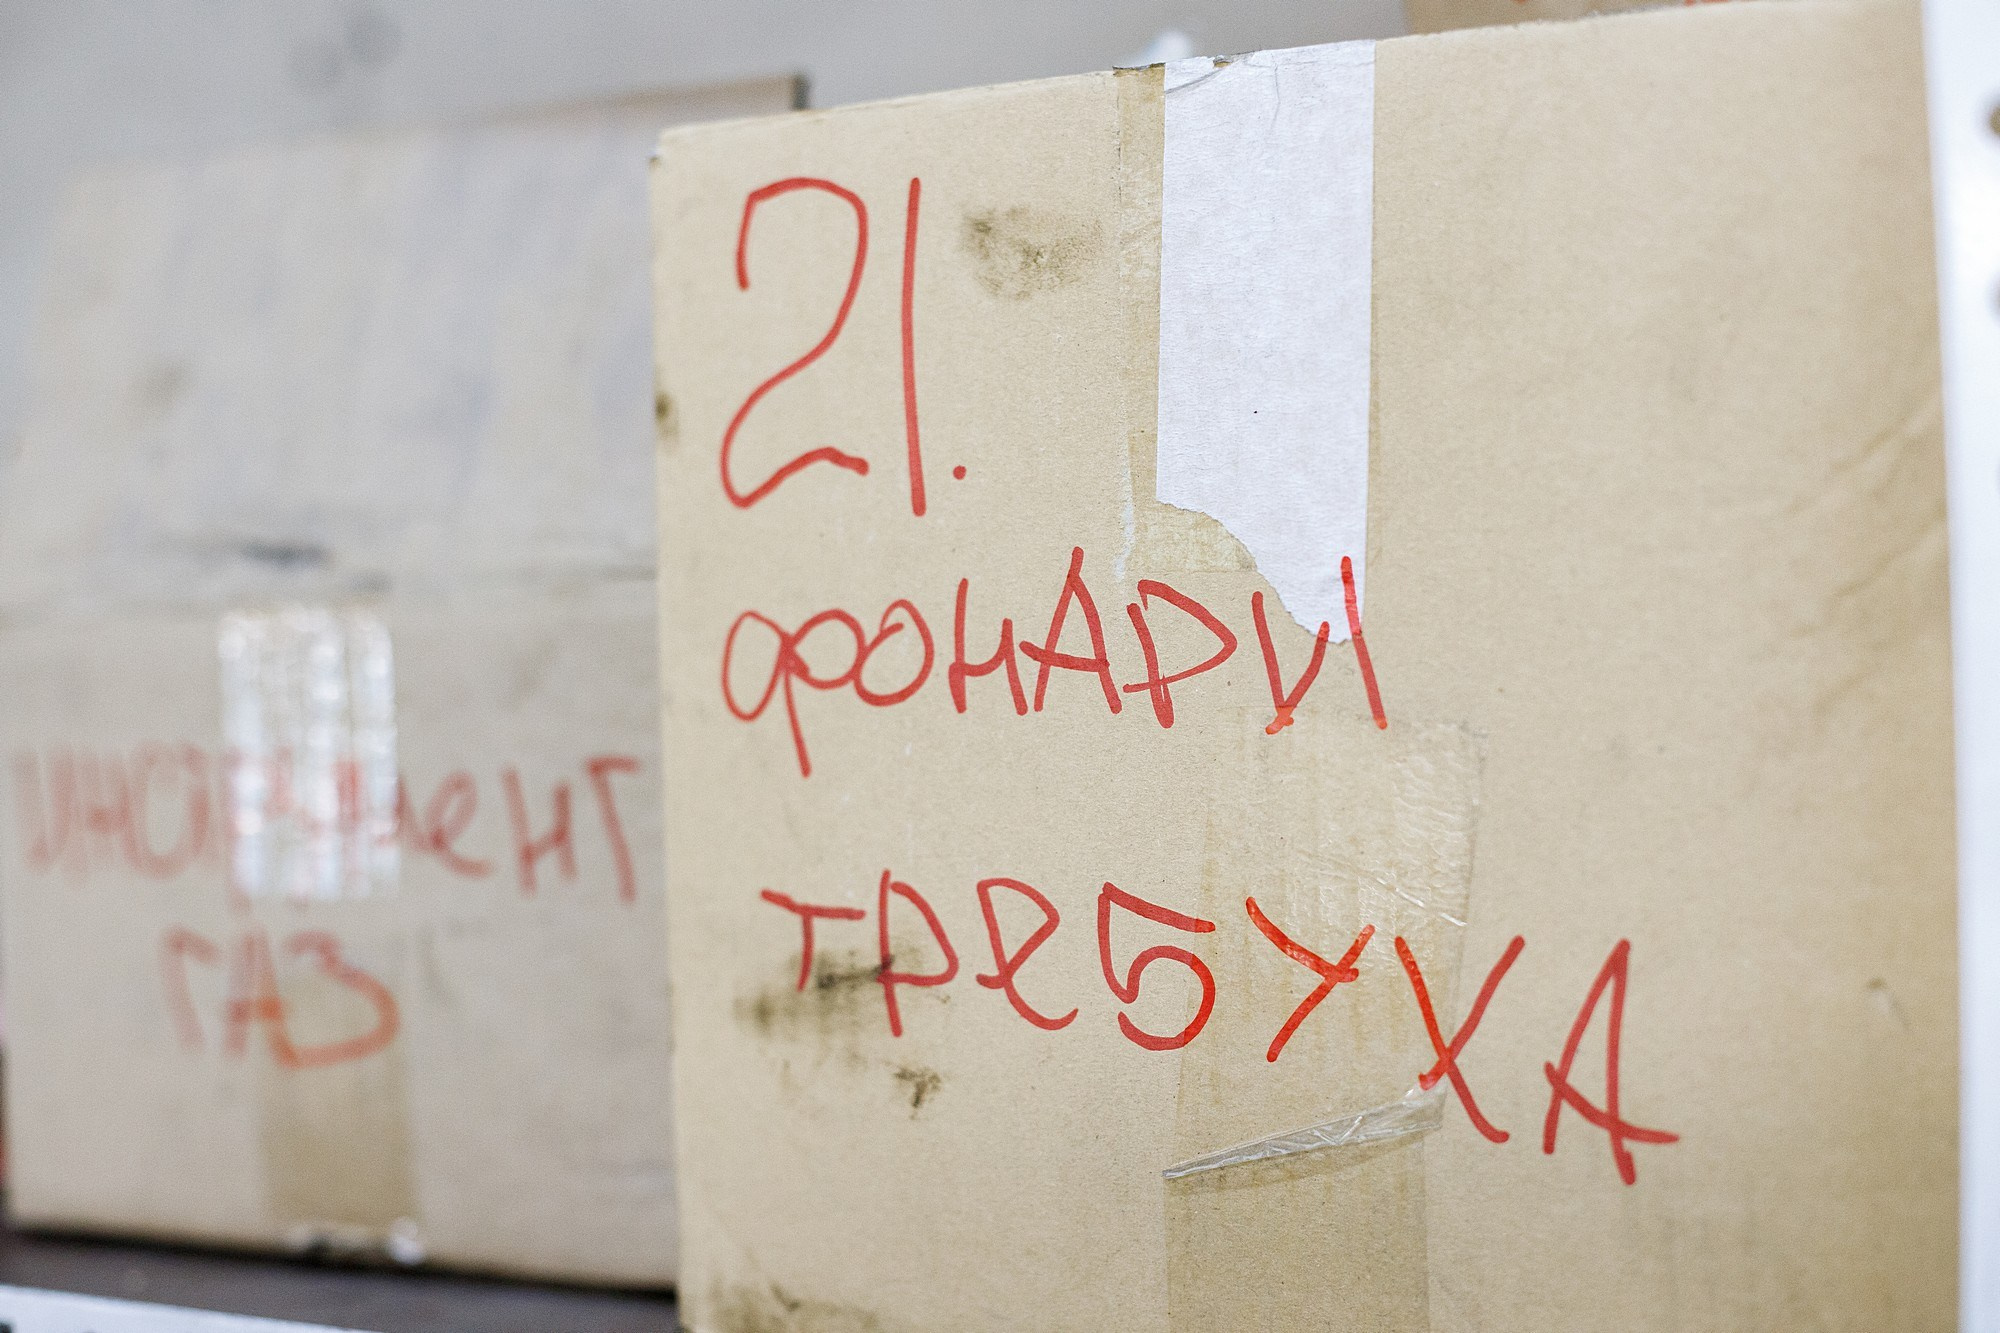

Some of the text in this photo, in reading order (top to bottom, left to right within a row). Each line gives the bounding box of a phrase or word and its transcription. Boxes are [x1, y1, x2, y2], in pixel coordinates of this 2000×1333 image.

[719, 176, 968, 518] 21.
[162, 924, 402, 1070] ГАЗ
[760, 869, 1681, 1186] ТРЕБУХА
